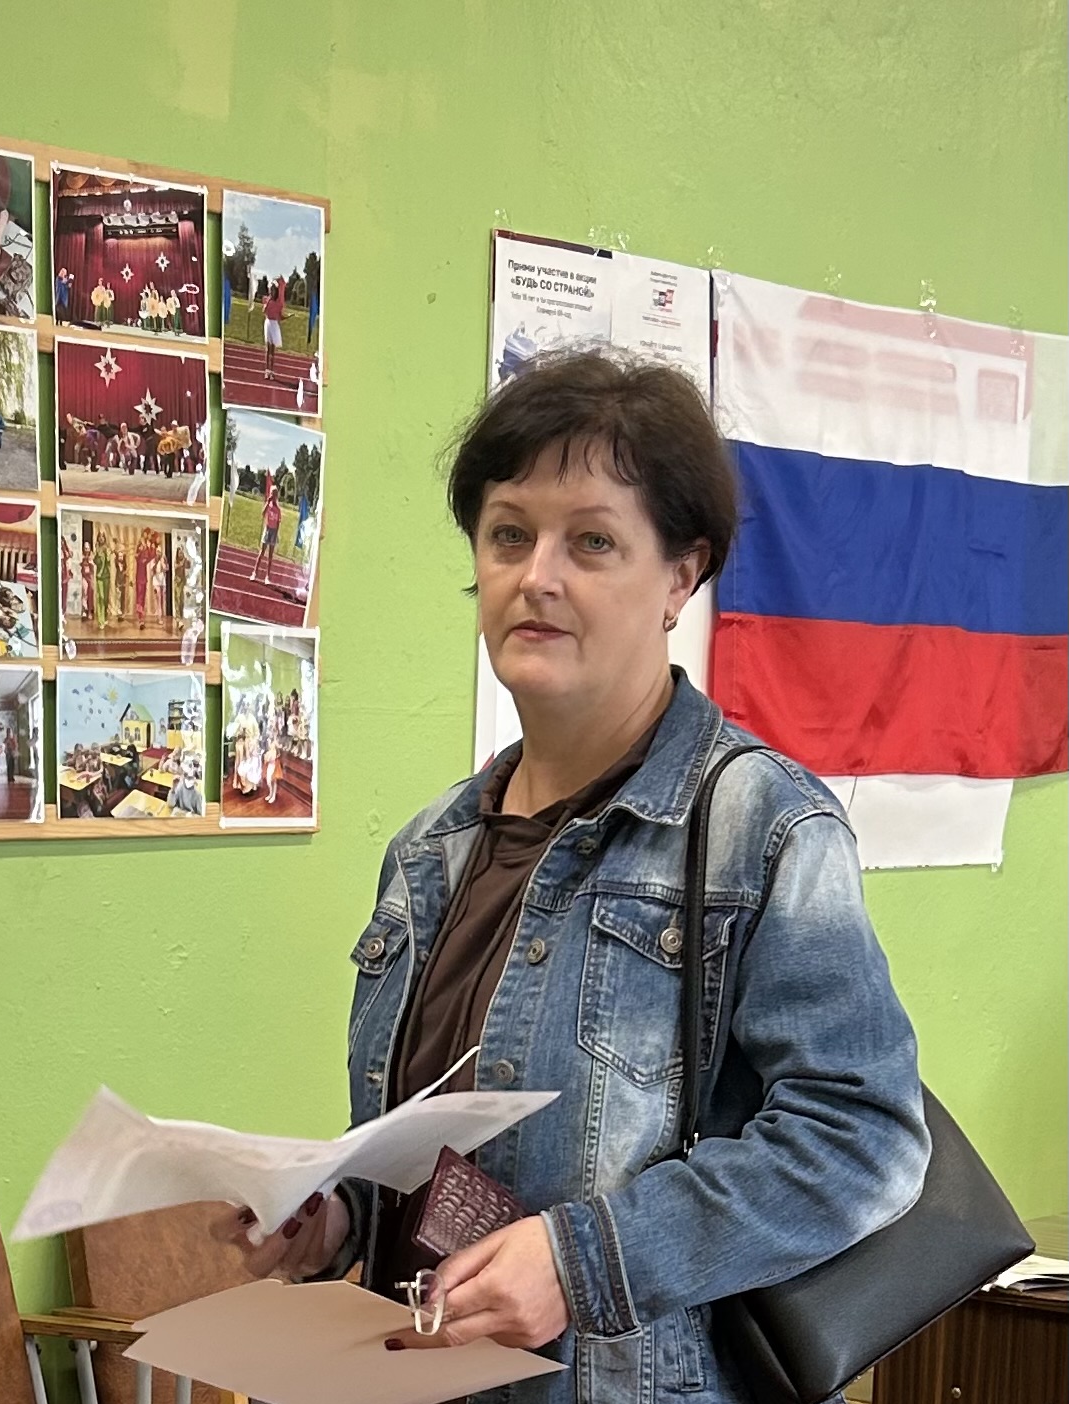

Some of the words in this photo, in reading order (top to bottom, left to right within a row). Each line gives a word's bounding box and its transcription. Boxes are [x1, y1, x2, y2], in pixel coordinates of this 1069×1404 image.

[537, 265, 569, 279] участие
[510, 275, 538, 289] «БУДЬ
[539, 279, 552, 291] СО
[553, 281, 595, 298] СТРАНОЙ»
